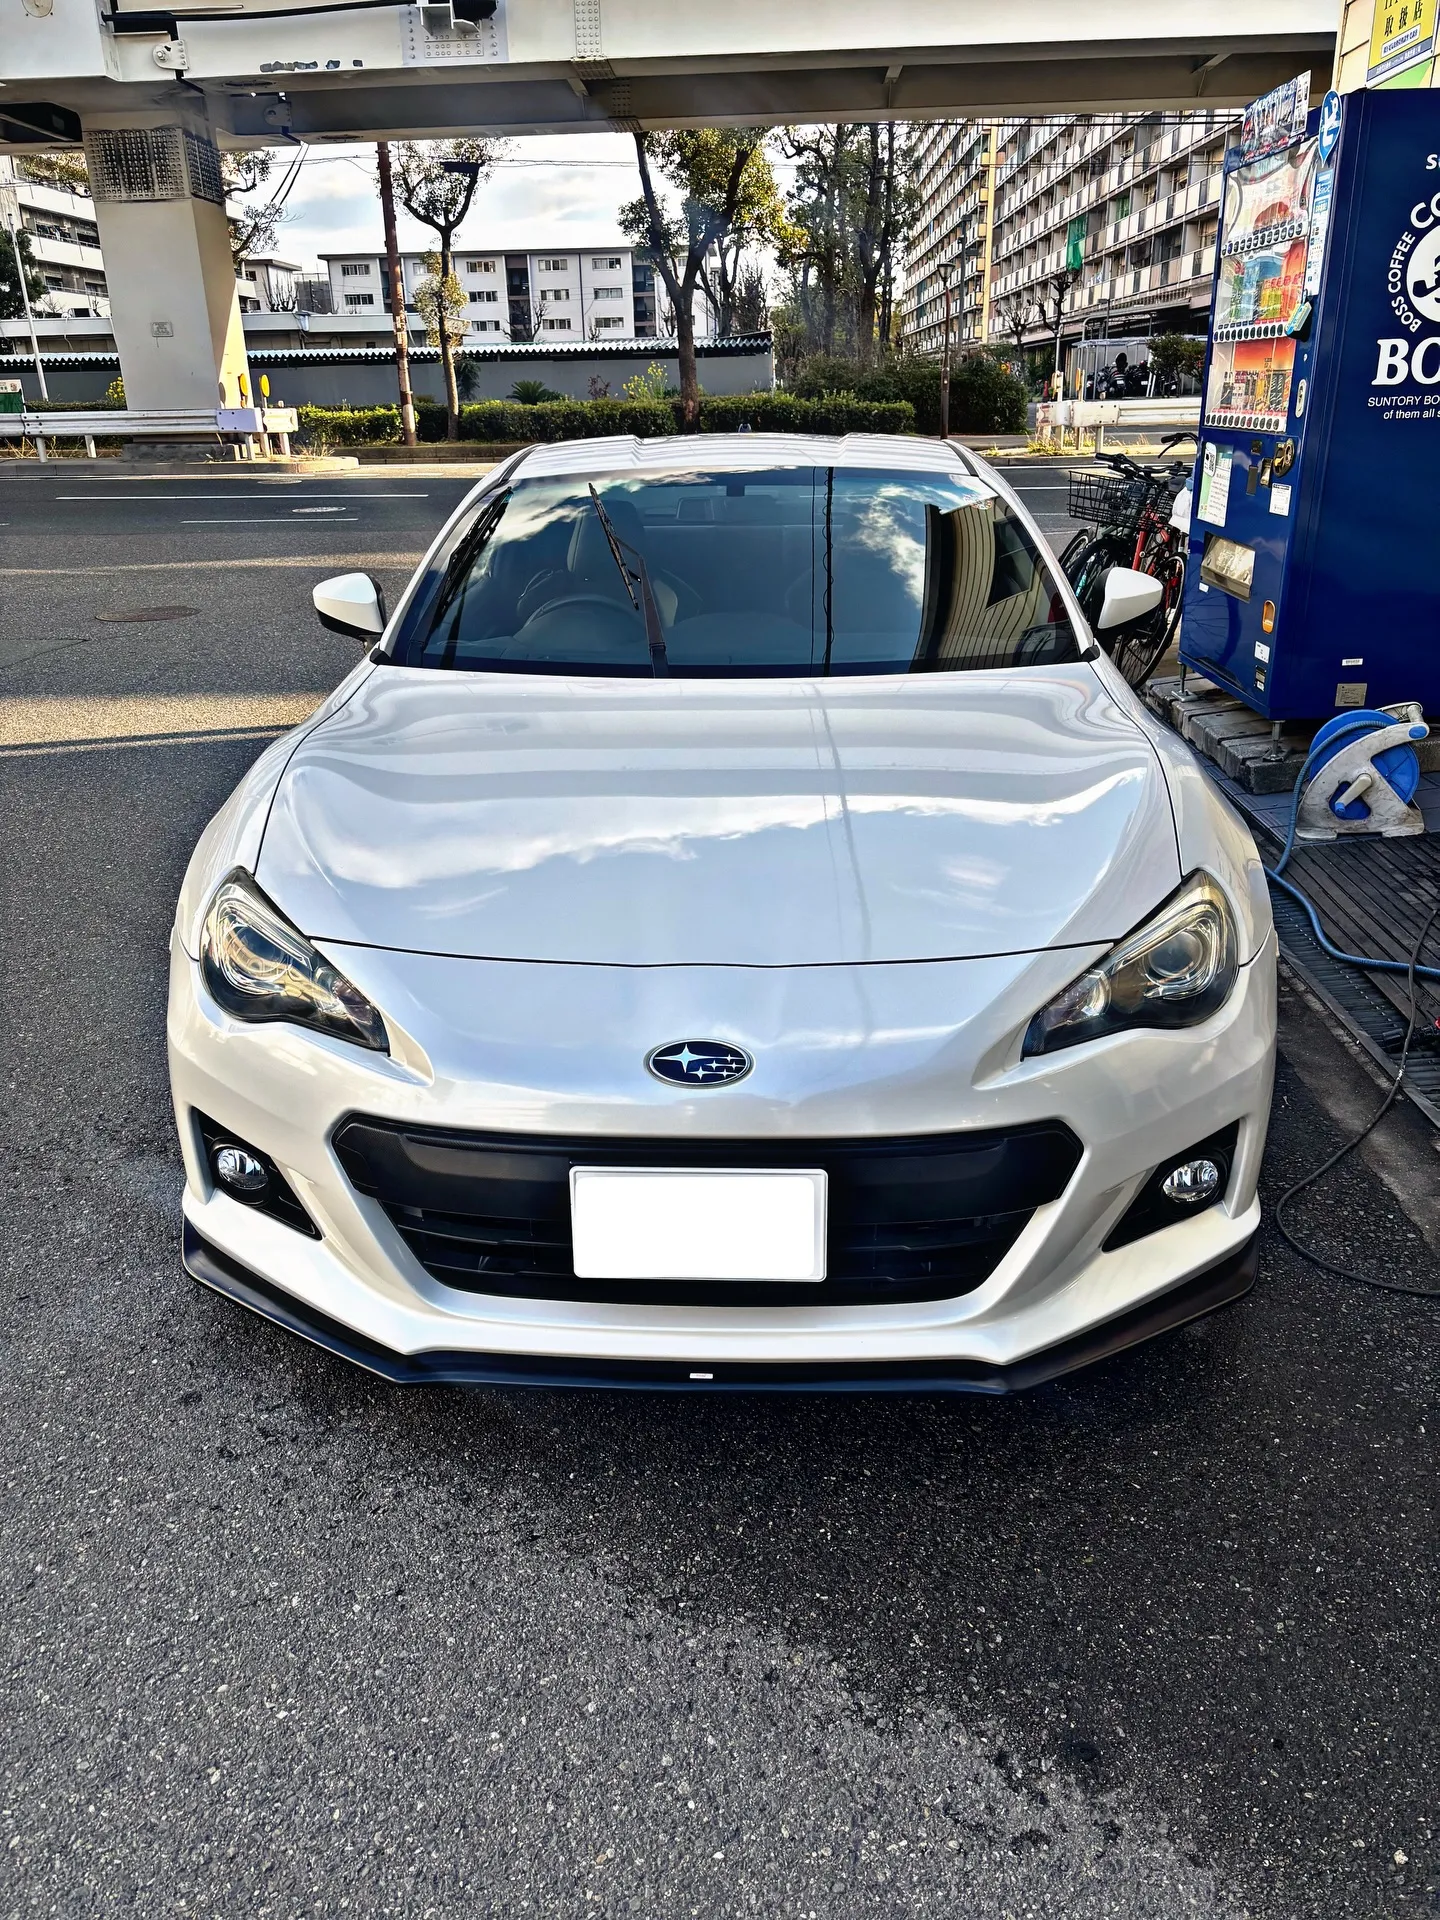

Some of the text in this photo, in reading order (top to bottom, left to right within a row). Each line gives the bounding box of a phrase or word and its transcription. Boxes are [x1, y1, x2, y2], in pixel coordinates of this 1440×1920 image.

[1425, 153, 1440, 170] S
[1388, 231, 1422, 333] BOSS COFFEE
[1367, 395, 1422, 407] SUNTORY
[1383, 409, 1394, 419] of
[1395, 409, 1420, 419] them
[1422, 408, 1435, 418] all
